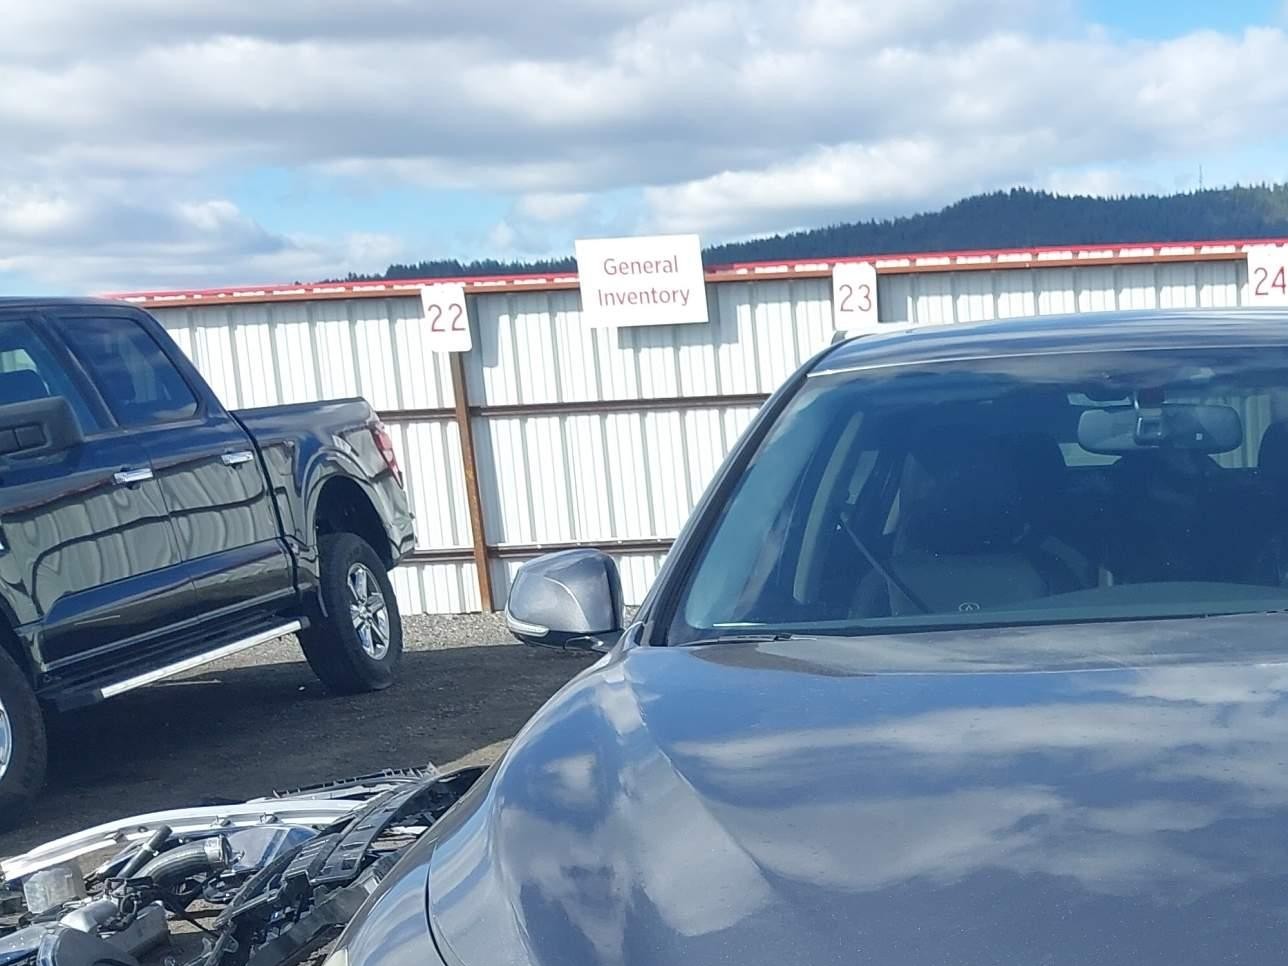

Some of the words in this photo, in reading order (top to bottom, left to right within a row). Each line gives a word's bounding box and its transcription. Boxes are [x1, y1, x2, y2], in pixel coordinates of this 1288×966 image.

[603, 255, 679, 276] General
[1253, 265, 1287, 297] 24
[598, 287, 690, 307] Inventory
[838, 283, 872, 313] 23
[427, 303, 467, 332] 22
